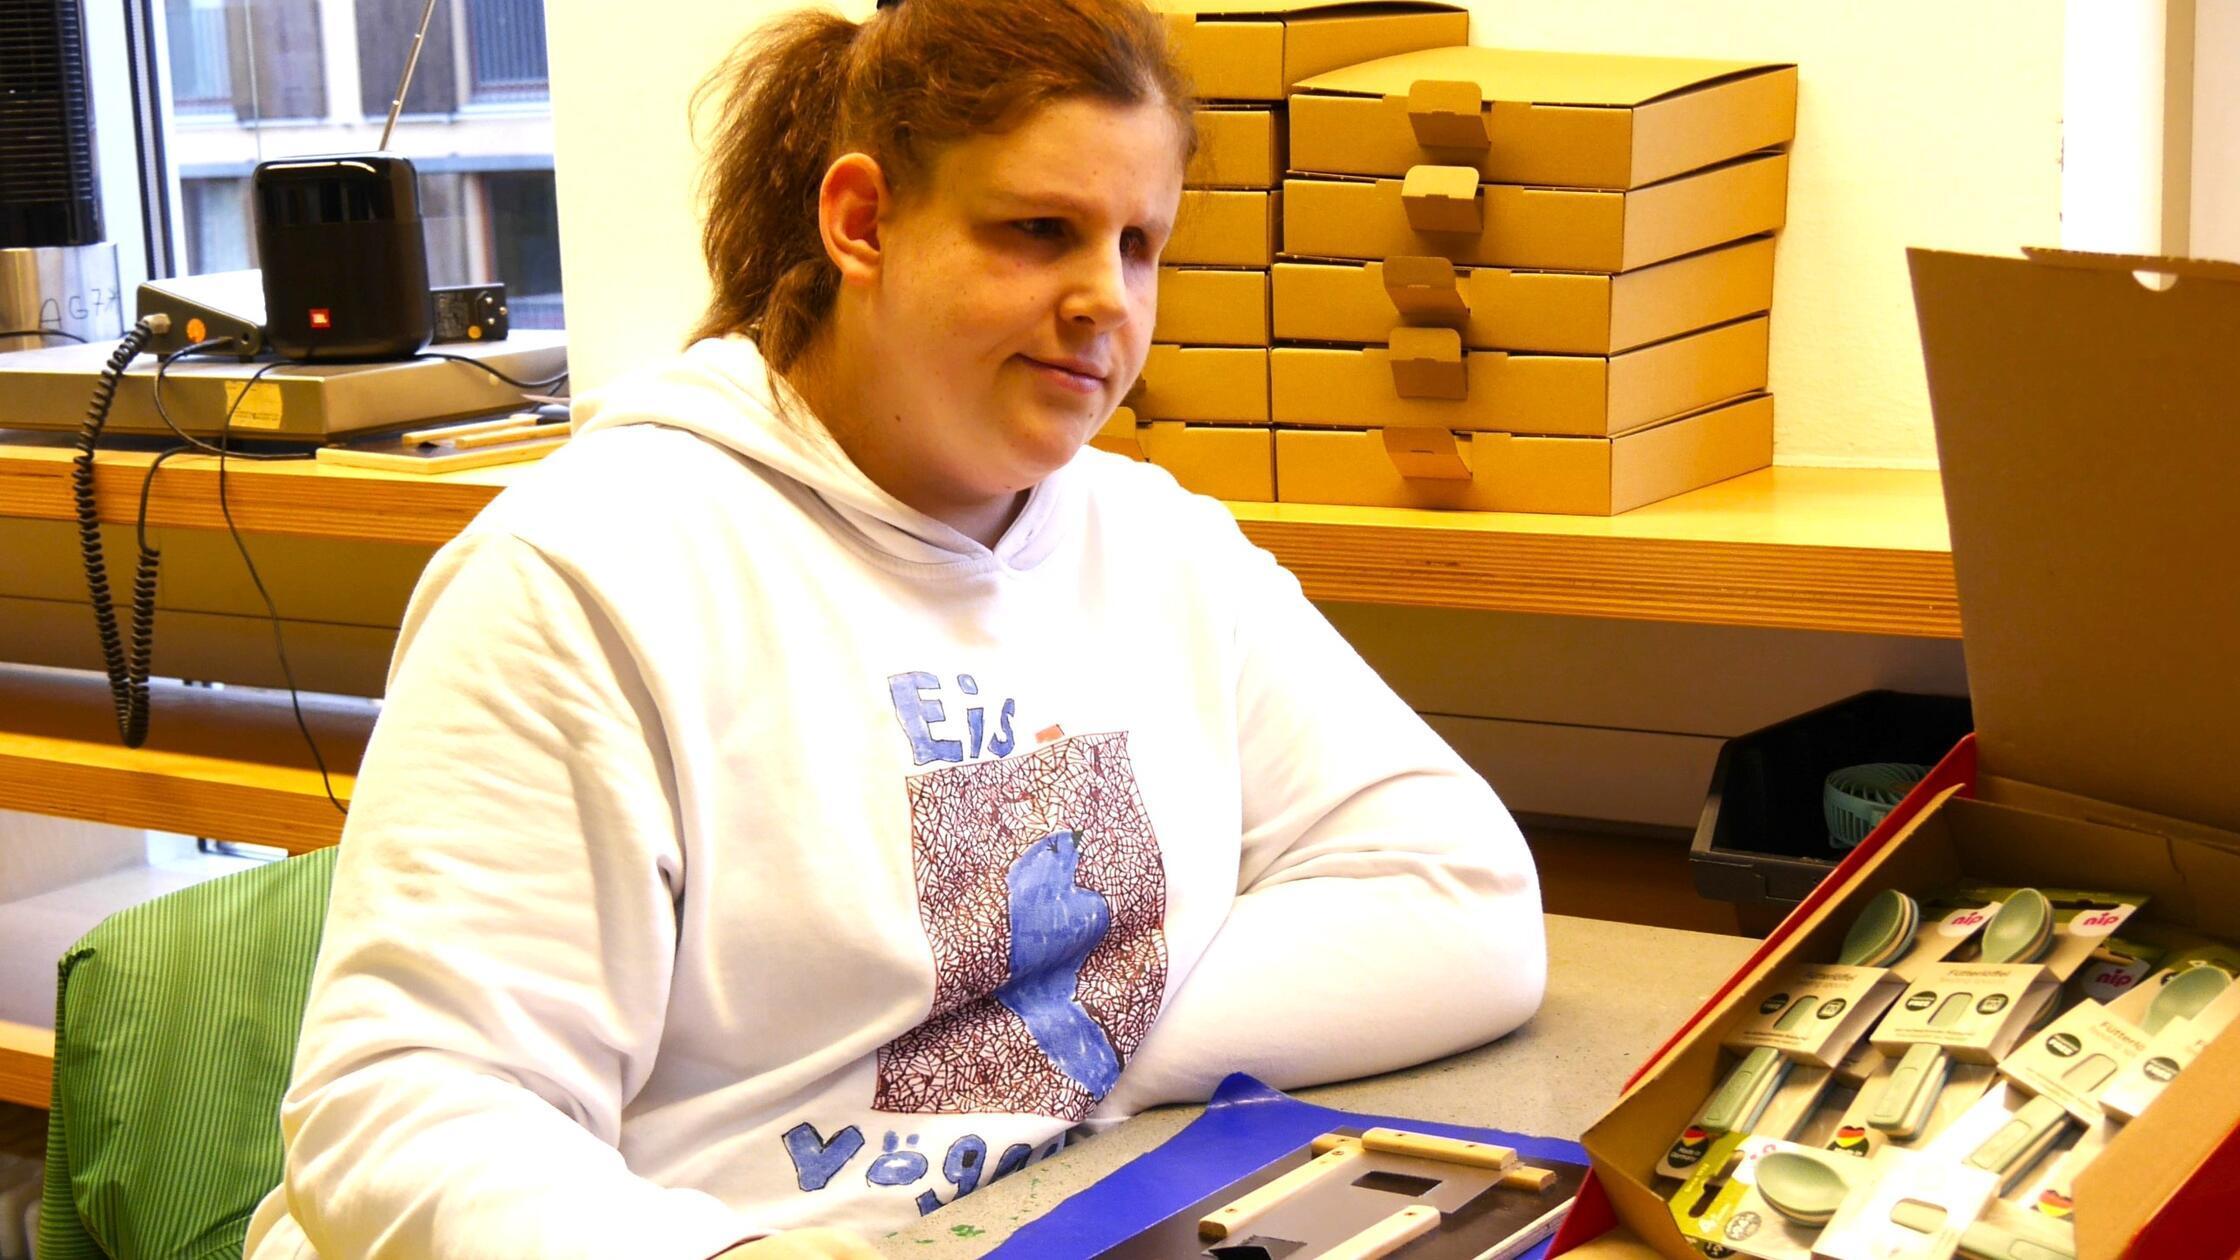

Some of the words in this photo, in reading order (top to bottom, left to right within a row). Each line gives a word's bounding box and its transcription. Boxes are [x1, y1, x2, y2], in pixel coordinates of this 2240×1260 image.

[887, 671, 1015, 766] Eis
[1951, 911, 1985, 927] nip
[2083, 912, 2120, 928] nip
[2095, 968, 2132, 989] nip
